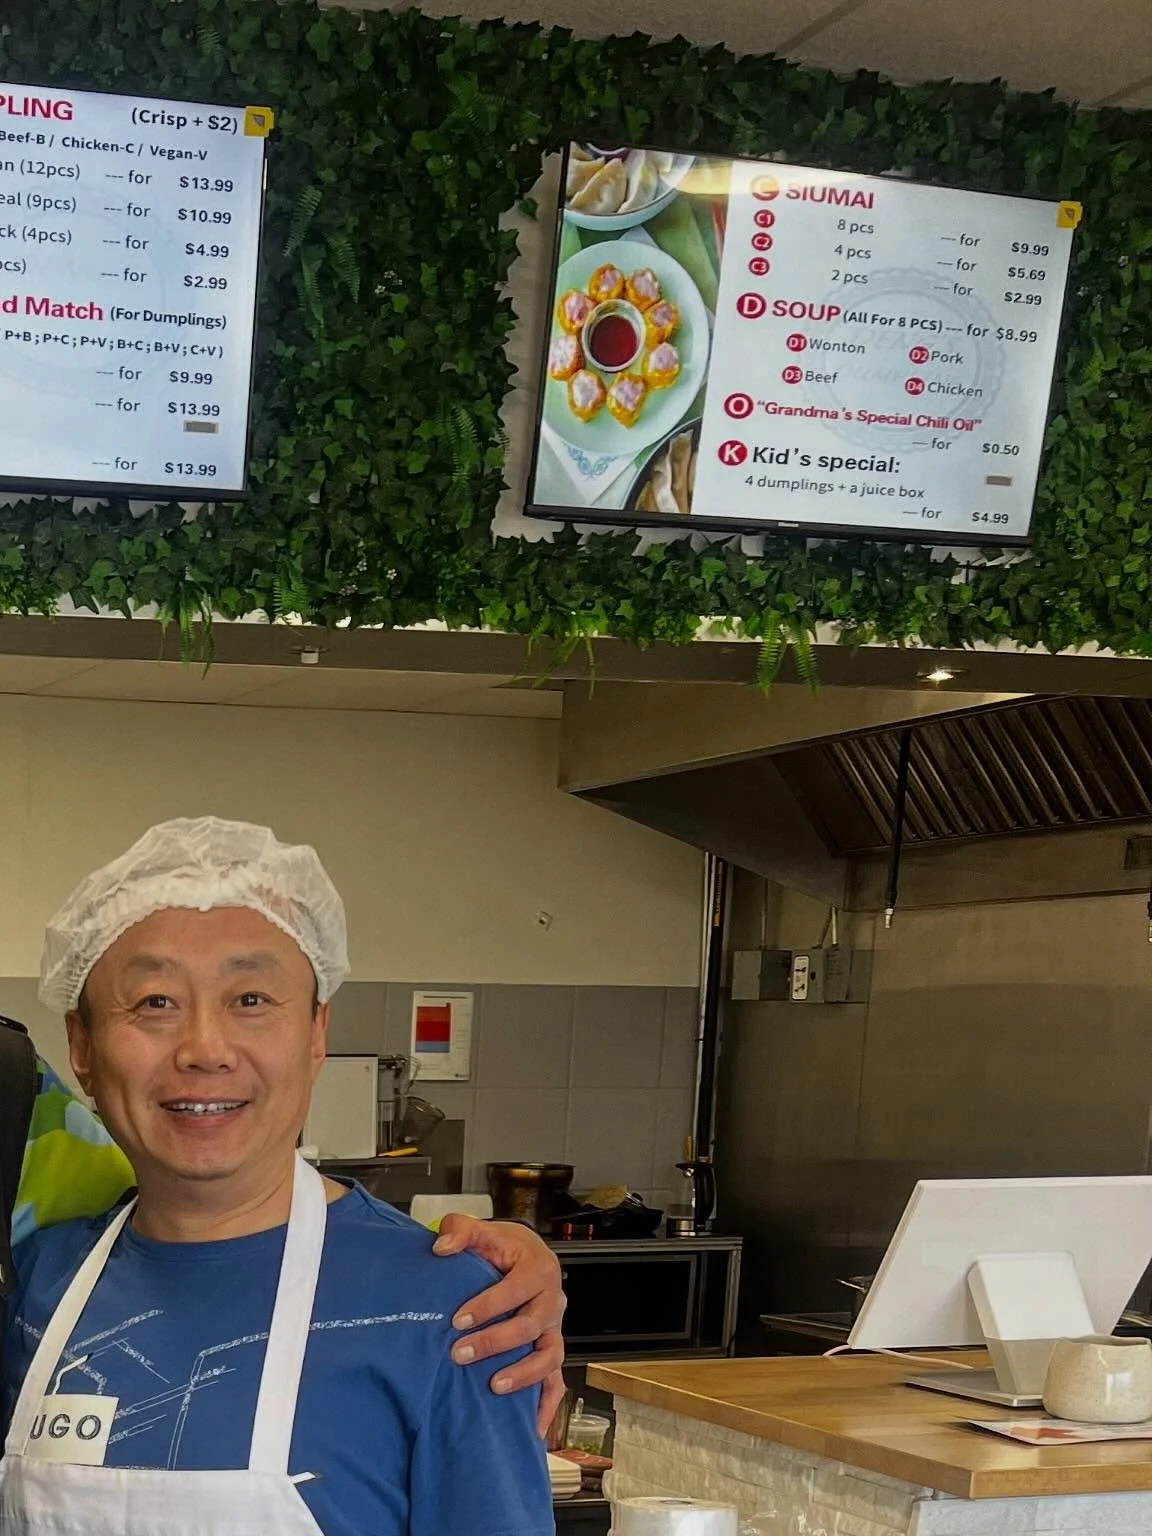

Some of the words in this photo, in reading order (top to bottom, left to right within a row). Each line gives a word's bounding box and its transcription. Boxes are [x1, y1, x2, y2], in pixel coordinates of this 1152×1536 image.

[132, 108, 187, 129] (Crisp
[208, 115, 238, 134] $2)
[62, 136, 134, 154] Chicken-C
[150, 145, 208, 161] Vegan-V
[20, 160, 81, 181] (12pcs)
[128, 171, 153, 185] for
[180, 175, 234, 193] $13.99
[26, 193, 77, 214] (9pcs)
[127, 203, 151, 218] for
[178, 207, 232, 225] $10.99
[785, 184, 874, 210] SIUMAI
[22, 225, 73, 246] (4pcs)
[125, 236, 149, 250] for
[185, 242, 229, 259] $4.99
[837, 220, 846, 231] 8
[849, 223, 874, 235] pcs
[960, 235, 981, 248] for
[1012, 242, 1049, 256] $9.99
[834, 246, 843, 256] 4
[846, 248, 871, 260] pcs
[956, 259, 977, 271] for
[1008, 267, 1046, 281] $5.69
[124, 269, 147, 283] for
[183, 274, 228, 291] $2.99
[832, 270, 840, 281] 2
[843, 273, 868, 285] pcs
[953, 284, 973, 296] for
[1004, 291, 1042, 306] $2.99
[25, 296, 104, 321] Match
[110, 307, 140, 322] (For
[143, 309, 227, 330] Dumplings)
[772, 299, 841, 322] SOUP
[843, 309, 867, 325] (All
[871, 313, 895, 327] For
[898, 317, 907, 328] 8
[910, 318, 943, 334] PCS)
[967, 324, 989, 338] for
[996, 327, 1038, 343] $8.99
[810, 338, 865, 354] Wonton
[931, 351, 964, 364] Pork
[118, 367, 142, 382] for
[169, 370, 213, 386] $9.99
[805, 370, 839, 384] Beef
[927, 381, 983, 398] Chicken
[117, 398, 141, 413] for
[167, 401, 220, 417] $13.99
[857, 410, 912, 426] Special
[916, 414, 949, 430] Chili
[752, 446, 811, 467] Kid’s
[817, 454, 901, 473] special:
[932, 437, 952, 450] for
[982, 442, 1020, 456] $0.50
[115, 457, 138, 472] for
[164, 461, 217, 477] $13.99
[745, 475, 754, 487] 4
[757, 476, 834, 495] dumplings
[850, 484, 857, 493] a
[860, 483, 895, 497] juice
[899, 485, 925, 499] box
[921, 507, 942, 520] for
[972, 511, 1009, 525] $4.99
[30, 1413, 102, 1440] UGO
